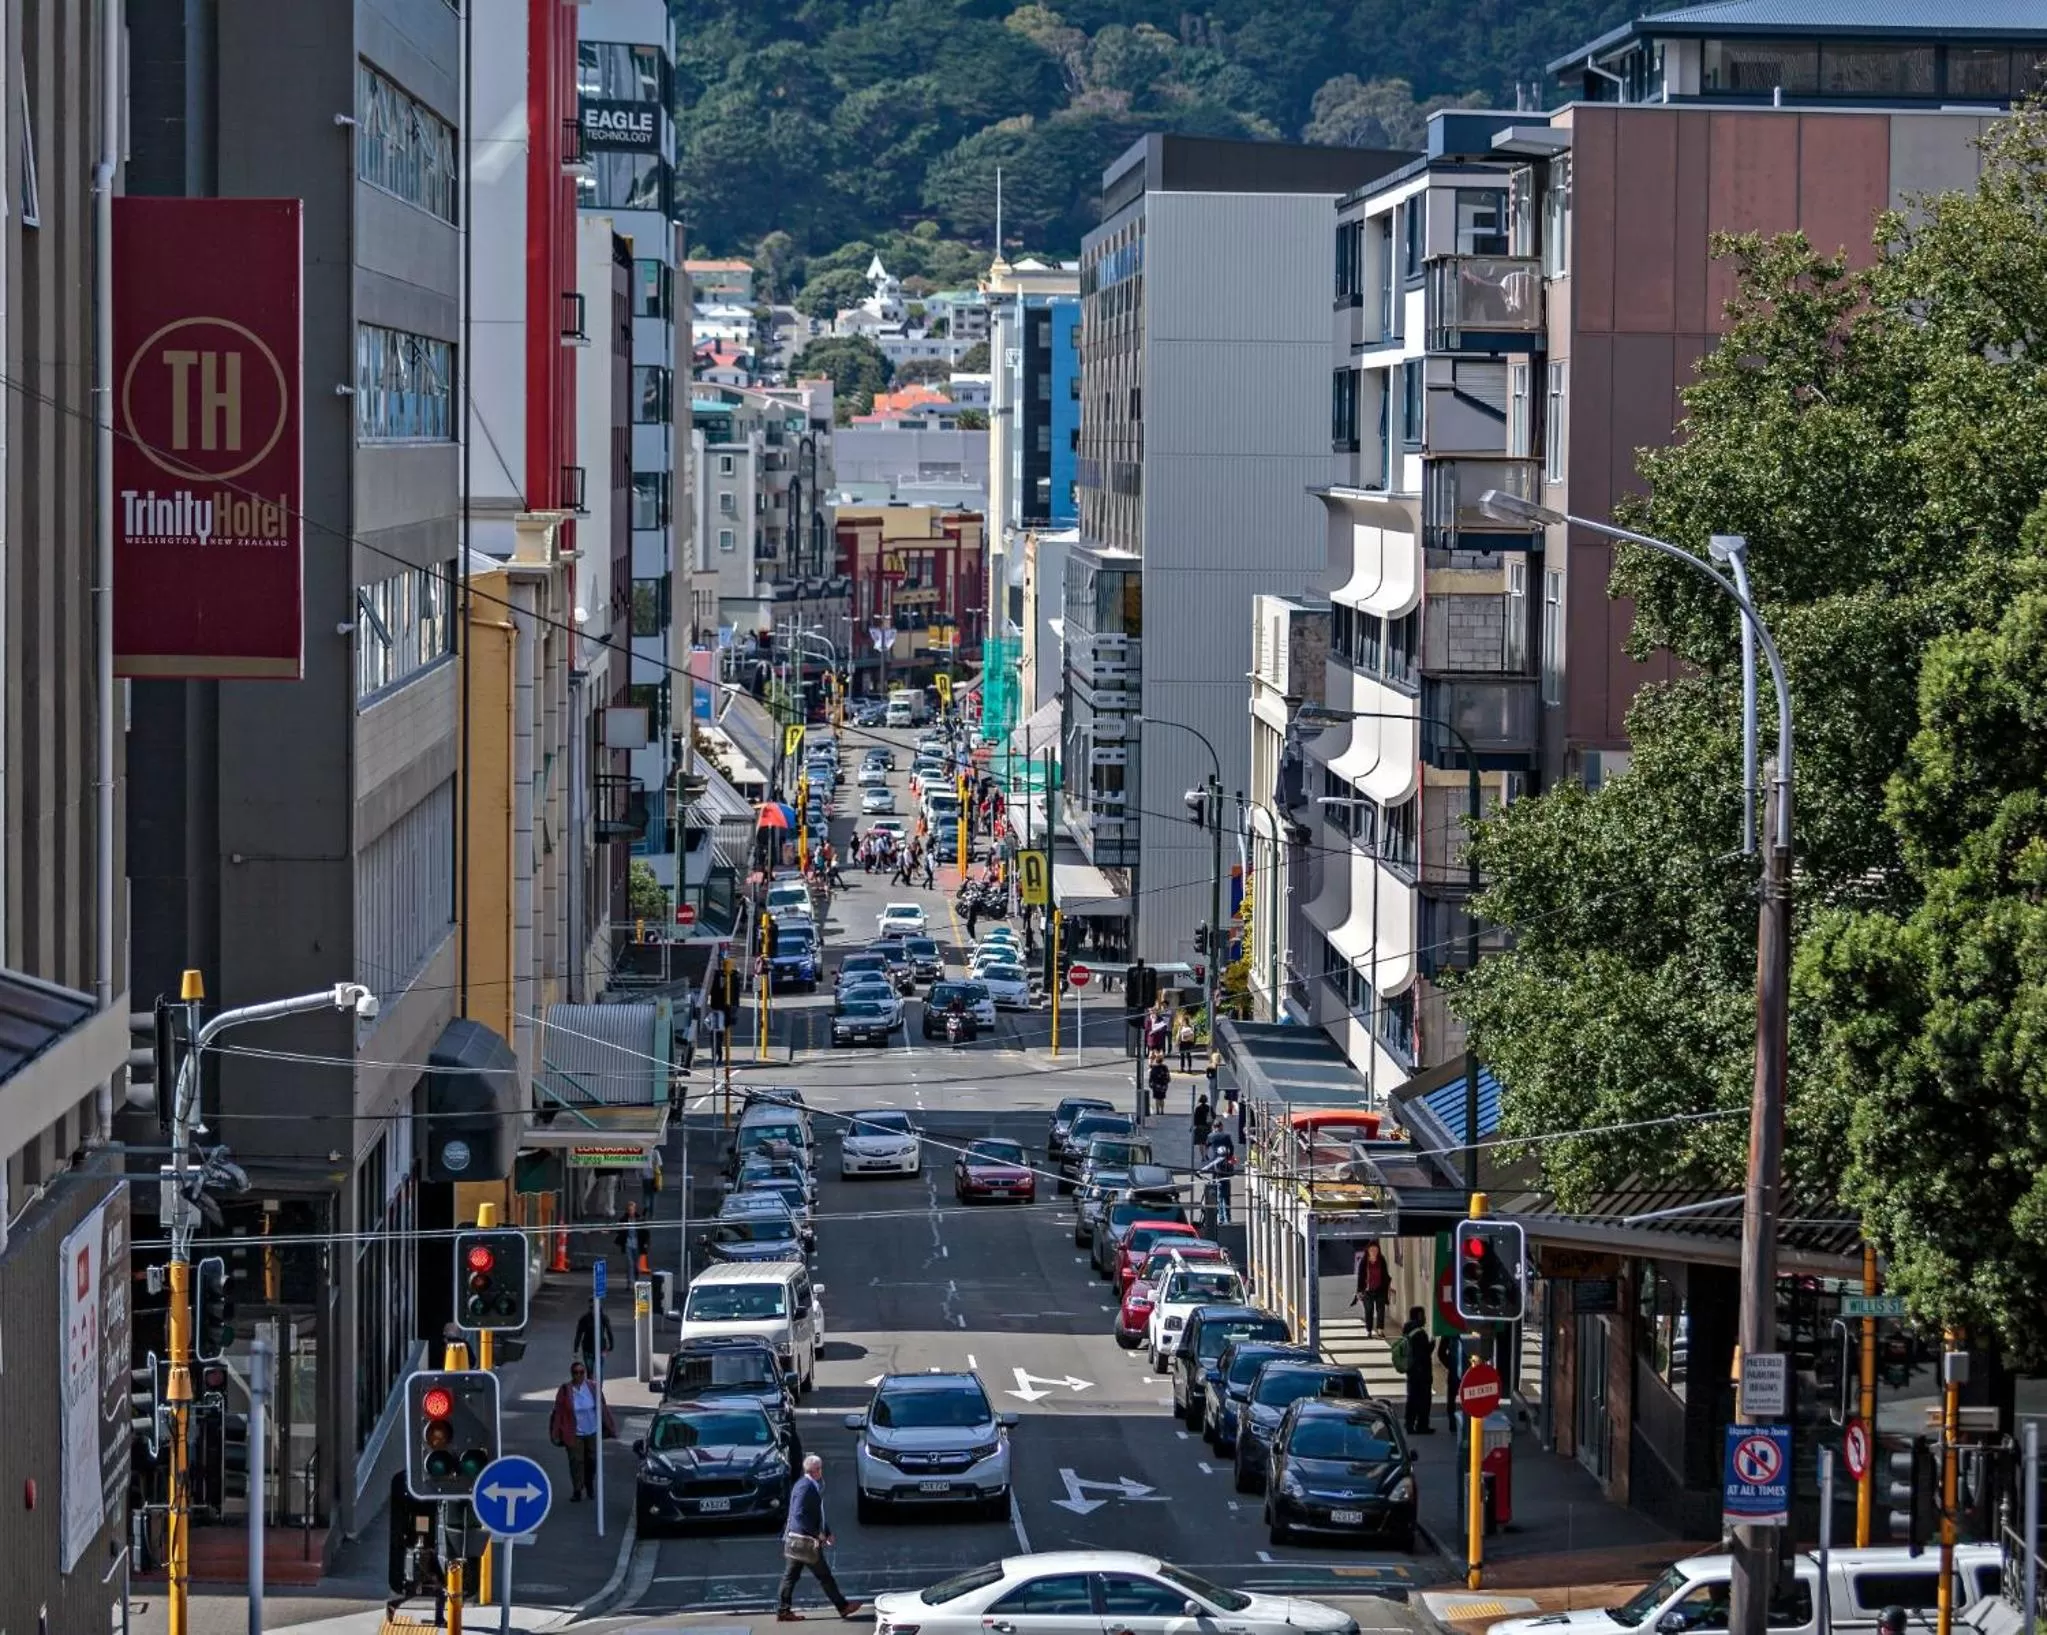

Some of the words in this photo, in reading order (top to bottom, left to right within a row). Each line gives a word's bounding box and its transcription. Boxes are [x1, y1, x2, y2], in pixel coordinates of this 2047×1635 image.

[585, 109, 653, 131] EAGLE
[587, 129, 652, 143] TECHNOLOGY
[163, 350, 241, 451] TH
[125, 537, 197, 545] WELLINGTON
[210, 538, 233, 546] NEW
[238, 539, 288, 547] ZEALAND
[1849, 1299, 1885, 1313] WILLIS
[1746, 1357, 1782, 1367] METERED
[1746, 1371, 1781, 1380] PARKING
[1749, 1383, 1778, 1392] BEGINS
[1727, 1485, 1738, 1496] AT
[1740, 1485, 1756, 1496] ALL
[1758, 1485, 1786, 1497] TIMES
